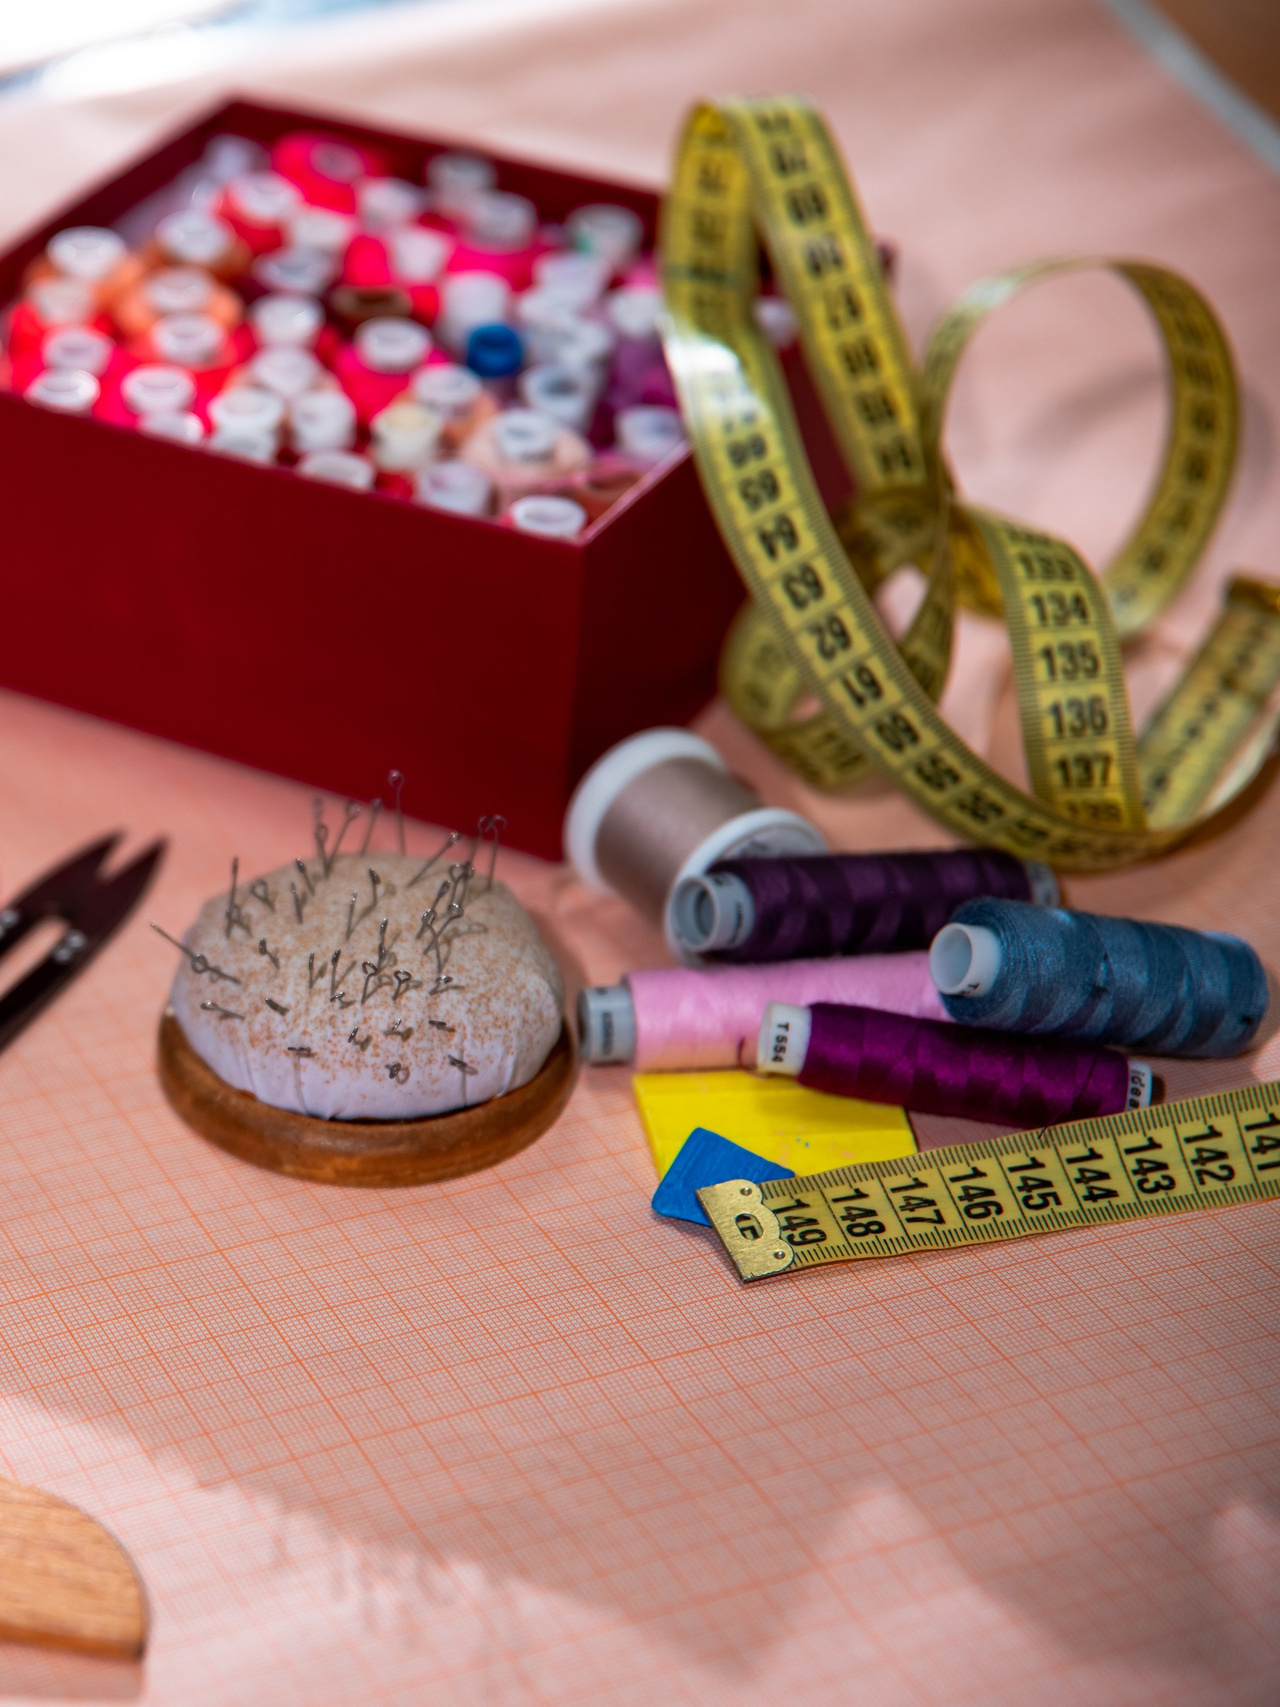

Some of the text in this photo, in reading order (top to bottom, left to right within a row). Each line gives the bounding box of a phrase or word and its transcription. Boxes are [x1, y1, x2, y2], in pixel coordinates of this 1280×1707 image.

[737, 467, 781, 514] 65
[755, 512, 801, 562] 64
[781, 558, 826, 611] 63
[1030, 590, 1090, 628] 134
[807, 613, 853, 662] 62
[1040, 640, 1101, 682] 135
[842, 663, 885, 708] 61
[875, 711, 921, 754] 60
[1049, 696, 1109, 740] 136
[1056, 752, 1112, 789] 137
[776, 1022, 791, 1032] T
[1065, 1147, 1119, 1203] 144
[1123, 1136, 1176, 1194] 143
[1183, 1124, 1237, 1186] 142
[890, 1177, 946, 1225] 147
[948, 1166, 1004, 1220] 146
[1007, 1156, 1062, 1211] 145
[771, 1198, 827, 1246] 149
[831, 1187, 886, 1237] 148
